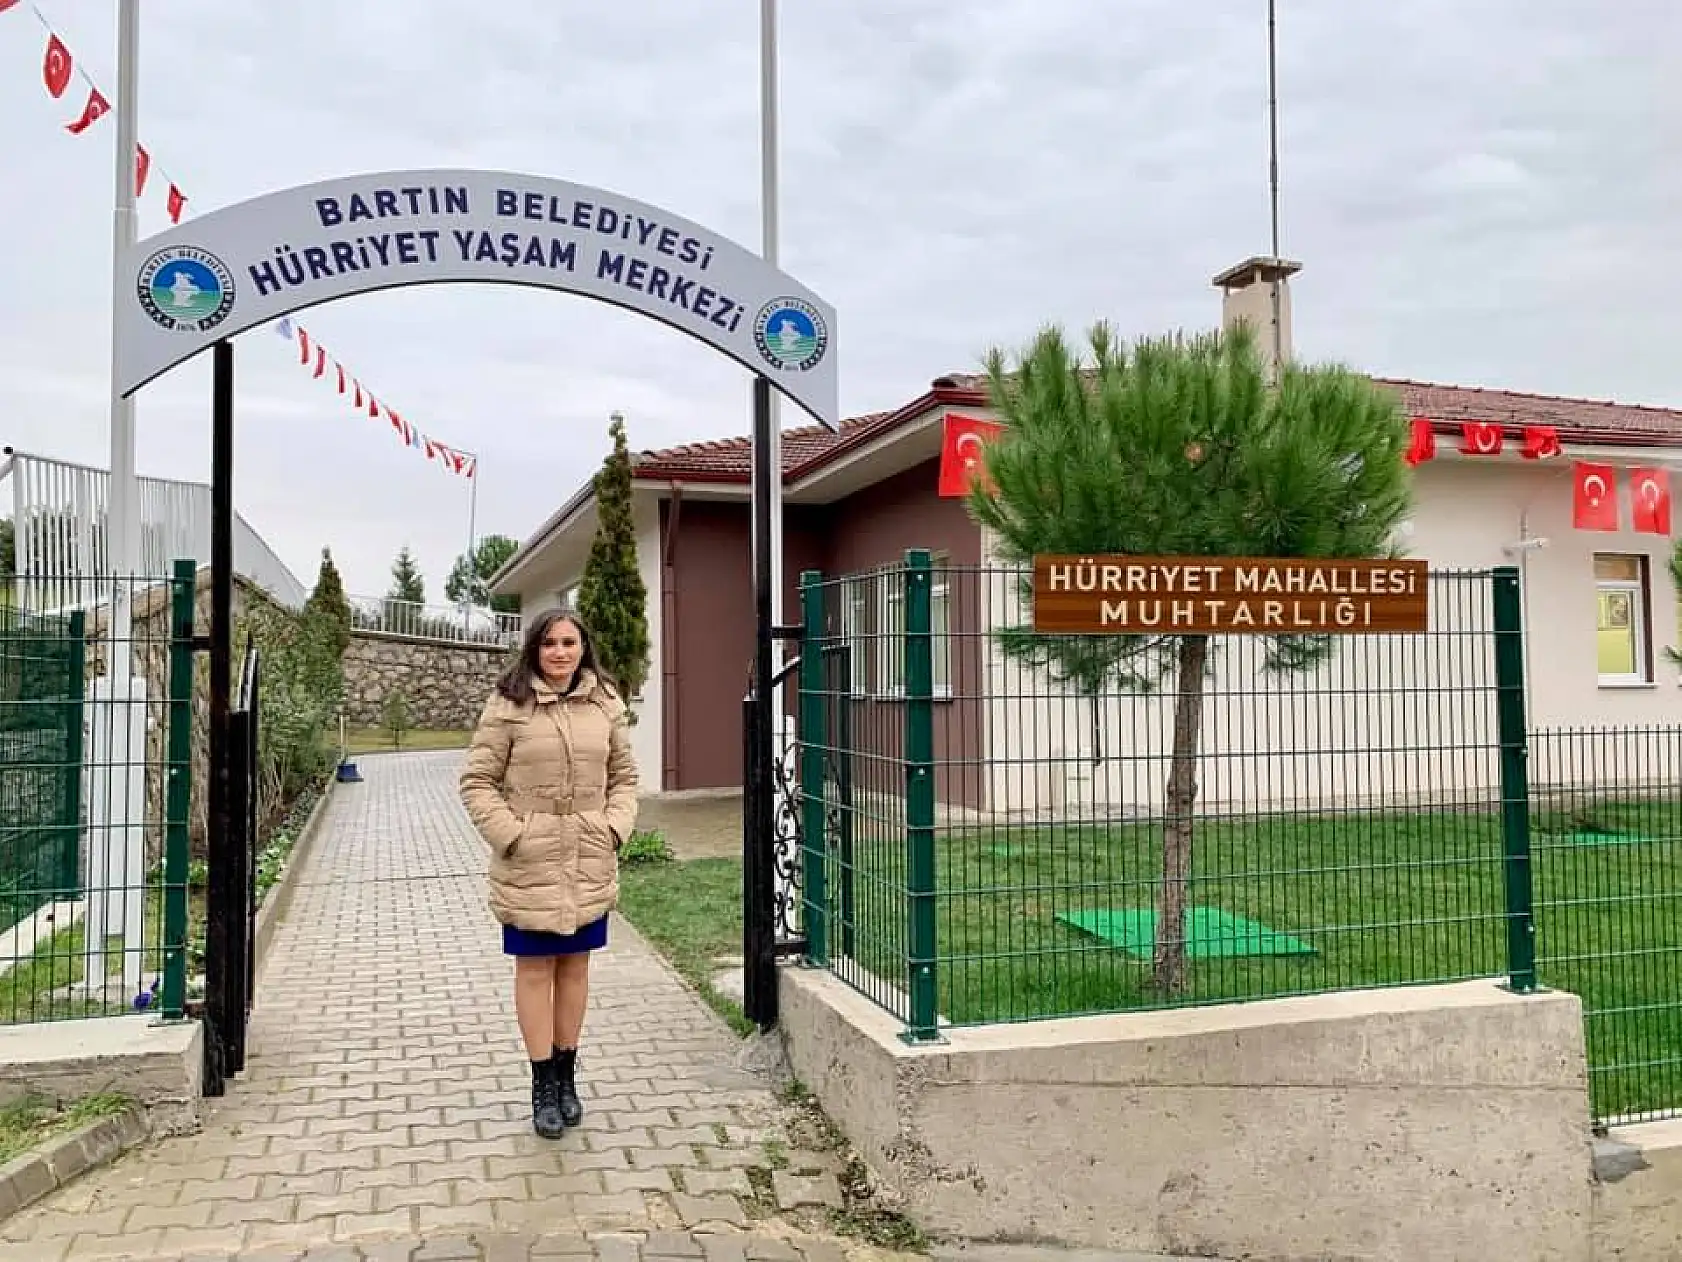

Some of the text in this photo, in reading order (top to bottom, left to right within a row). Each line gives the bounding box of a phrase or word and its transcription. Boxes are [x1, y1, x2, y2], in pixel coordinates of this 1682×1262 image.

[315, 186, 470, 227] BARTIN
[452, 229, 577, 272] YAŞAM
[1101, 597, 1371, 625] MUHTARLIĞI
